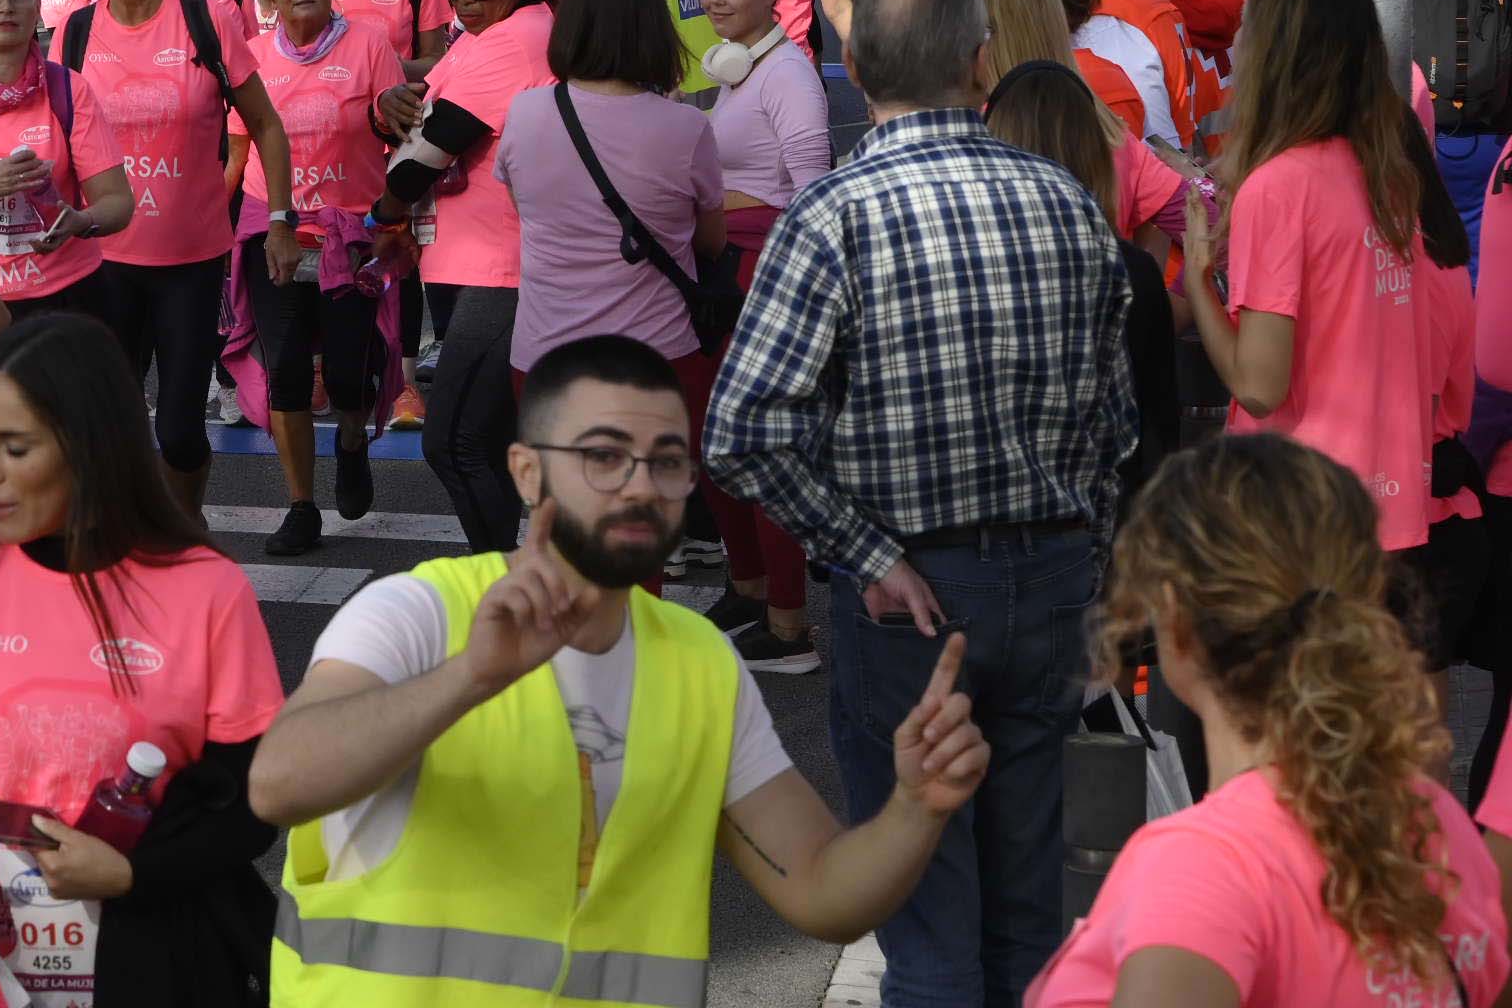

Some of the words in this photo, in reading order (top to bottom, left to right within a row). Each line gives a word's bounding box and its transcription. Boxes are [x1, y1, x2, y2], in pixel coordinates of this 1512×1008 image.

[124, 155, 182, 179] RSAL
[294, 162, 347, 188] RSAL
[1375, 268, 1412, 296] MUJE
[21, 922, 84, 947] 016
[33, 955, 72, 970] 4255
[34, 978, 48, 988] DE
[51, 978, 65, 988] LA
